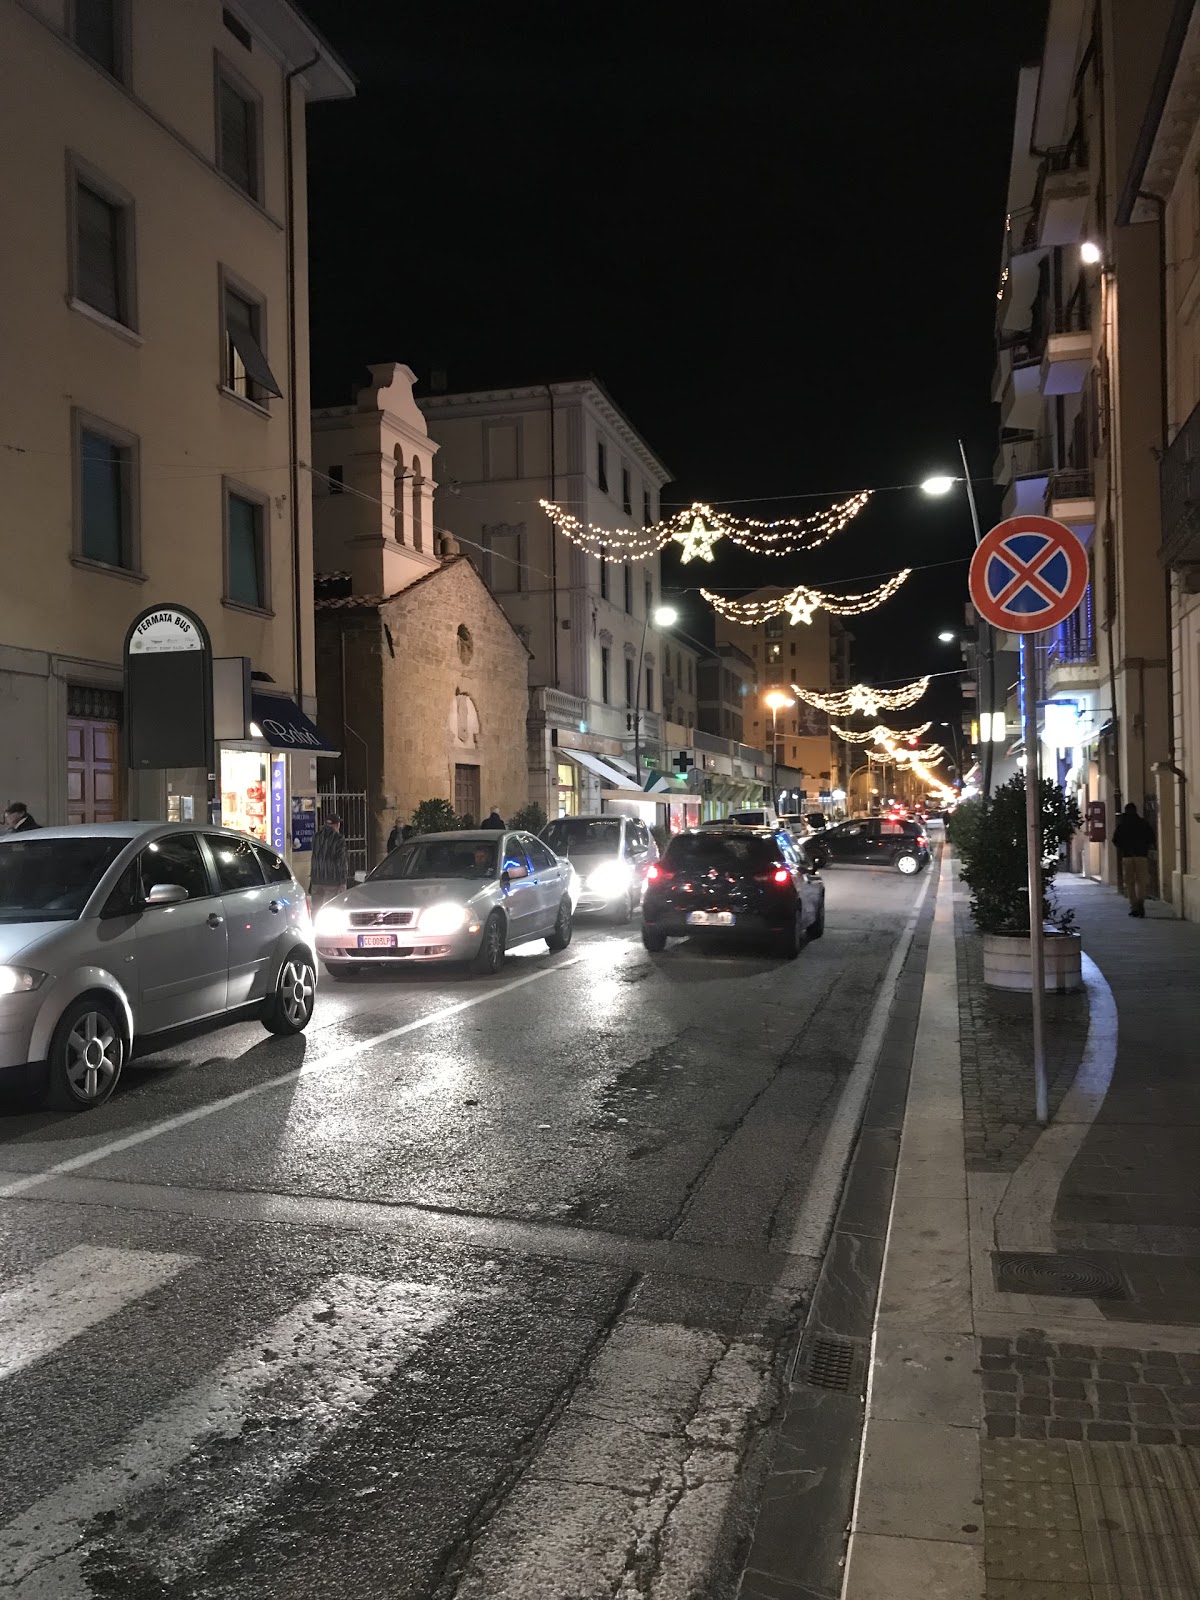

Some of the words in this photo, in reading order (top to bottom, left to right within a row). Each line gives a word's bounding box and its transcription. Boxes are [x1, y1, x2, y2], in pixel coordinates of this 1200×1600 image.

[137, 613, 172, 635] FERMATA
[174, 616, 191, 633] BUS
[274, 769, 282, 852] PASTICC
